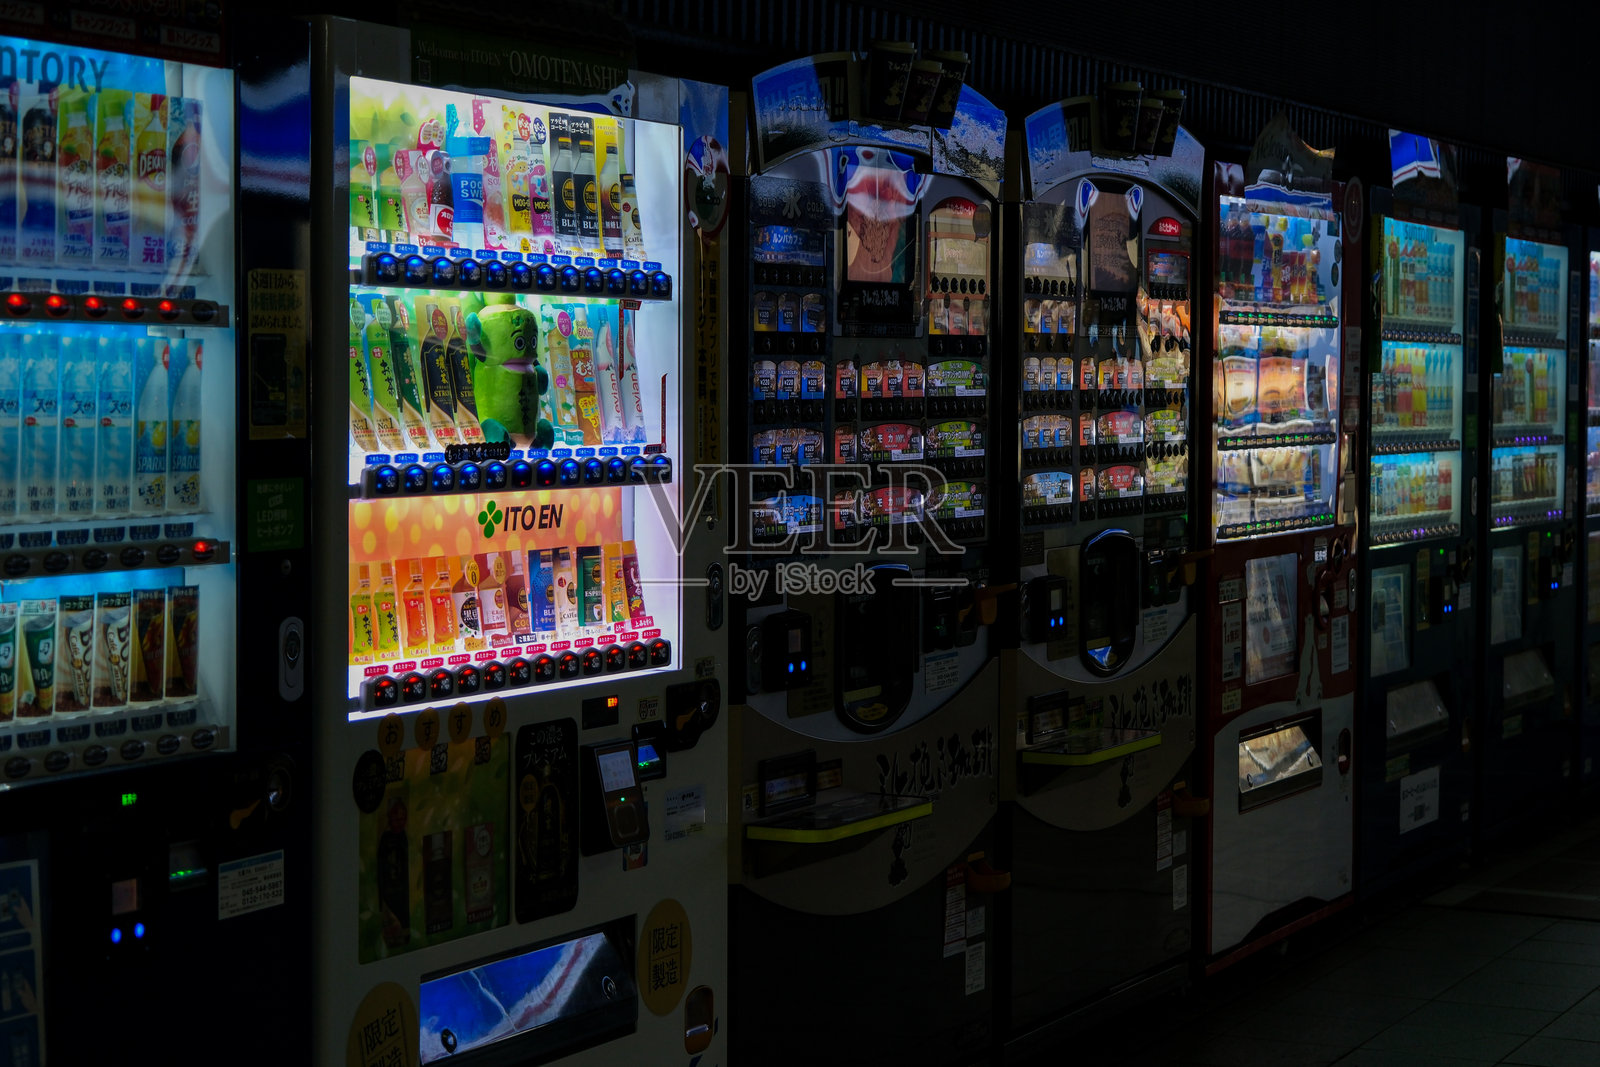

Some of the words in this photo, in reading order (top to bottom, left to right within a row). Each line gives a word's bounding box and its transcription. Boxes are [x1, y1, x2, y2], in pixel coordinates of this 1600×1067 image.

[417, 40, 458, 62] Welcome
[611, 373, 621, 414] evian
[632, 372, 642, 413] evian
[504, 505, 536, 531] ITO
[538, 503, 563, 529] EN
[653, 925, 679, 955] 限定
[653, 957, 679, 992] 製造
[364, 1008, 400, 1055] 限定
